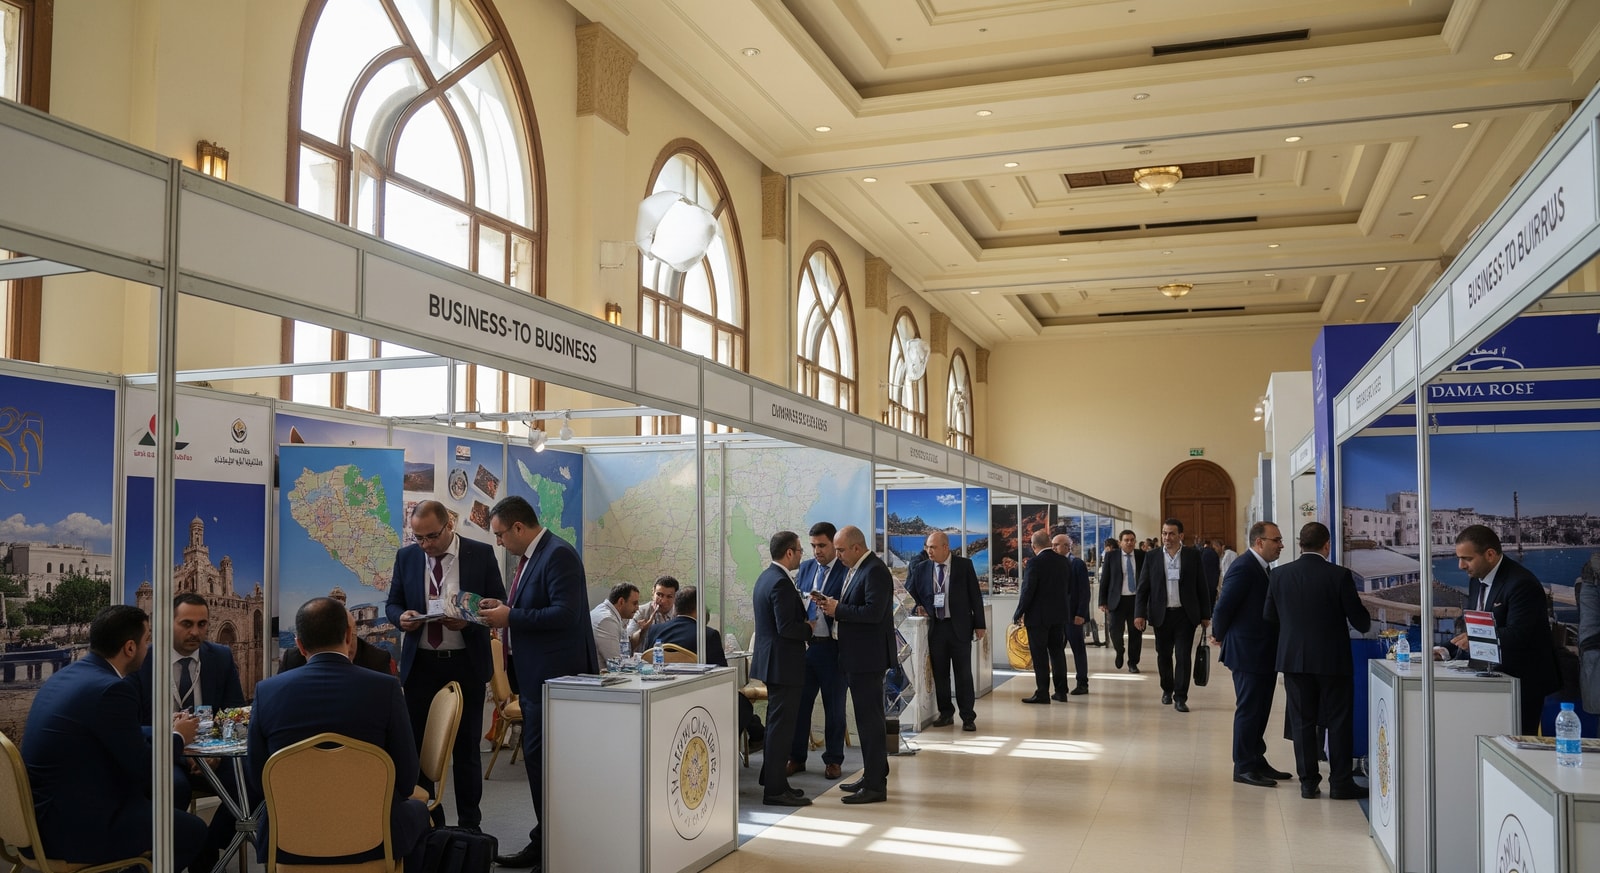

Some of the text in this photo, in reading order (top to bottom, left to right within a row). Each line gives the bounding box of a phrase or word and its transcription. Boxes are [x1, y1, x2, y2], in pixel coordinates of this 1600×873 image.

[1468, 239, 1517, 309] BUSINESS-TO
[429, 293, 597, 364] BUSINESS-TO BUSINESS
[1431, 383, 1536, 398] DAMA ROSE
